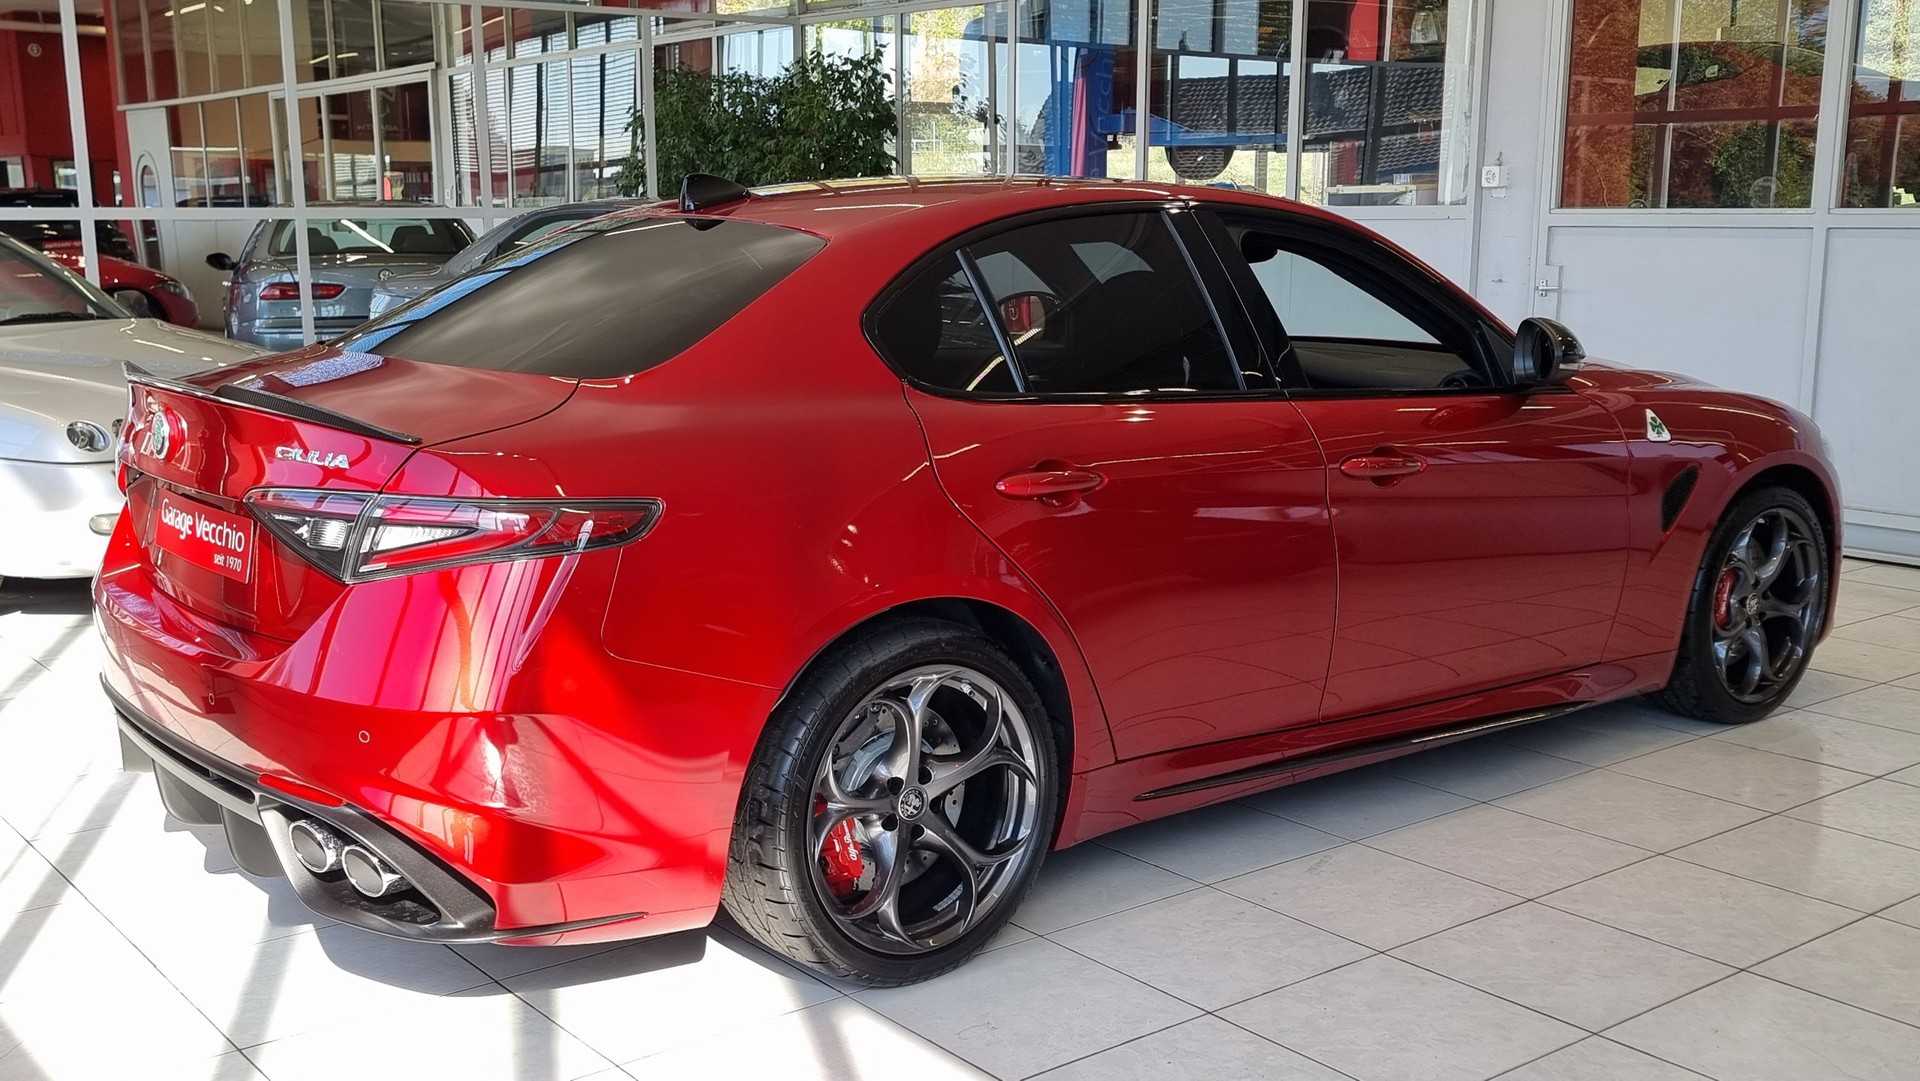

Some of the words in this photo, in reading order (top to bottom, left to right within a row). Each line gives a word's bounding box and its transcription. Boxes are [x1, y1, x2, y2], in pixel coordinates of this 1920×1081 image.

[275, 446, 350, 469] GIULIA
[161, 498, 193, 540] Garage
[195, 511, 245, 553] Vecchio
[213, 553, 225, 567] seit
[226, 555, 242, 572] 1970
